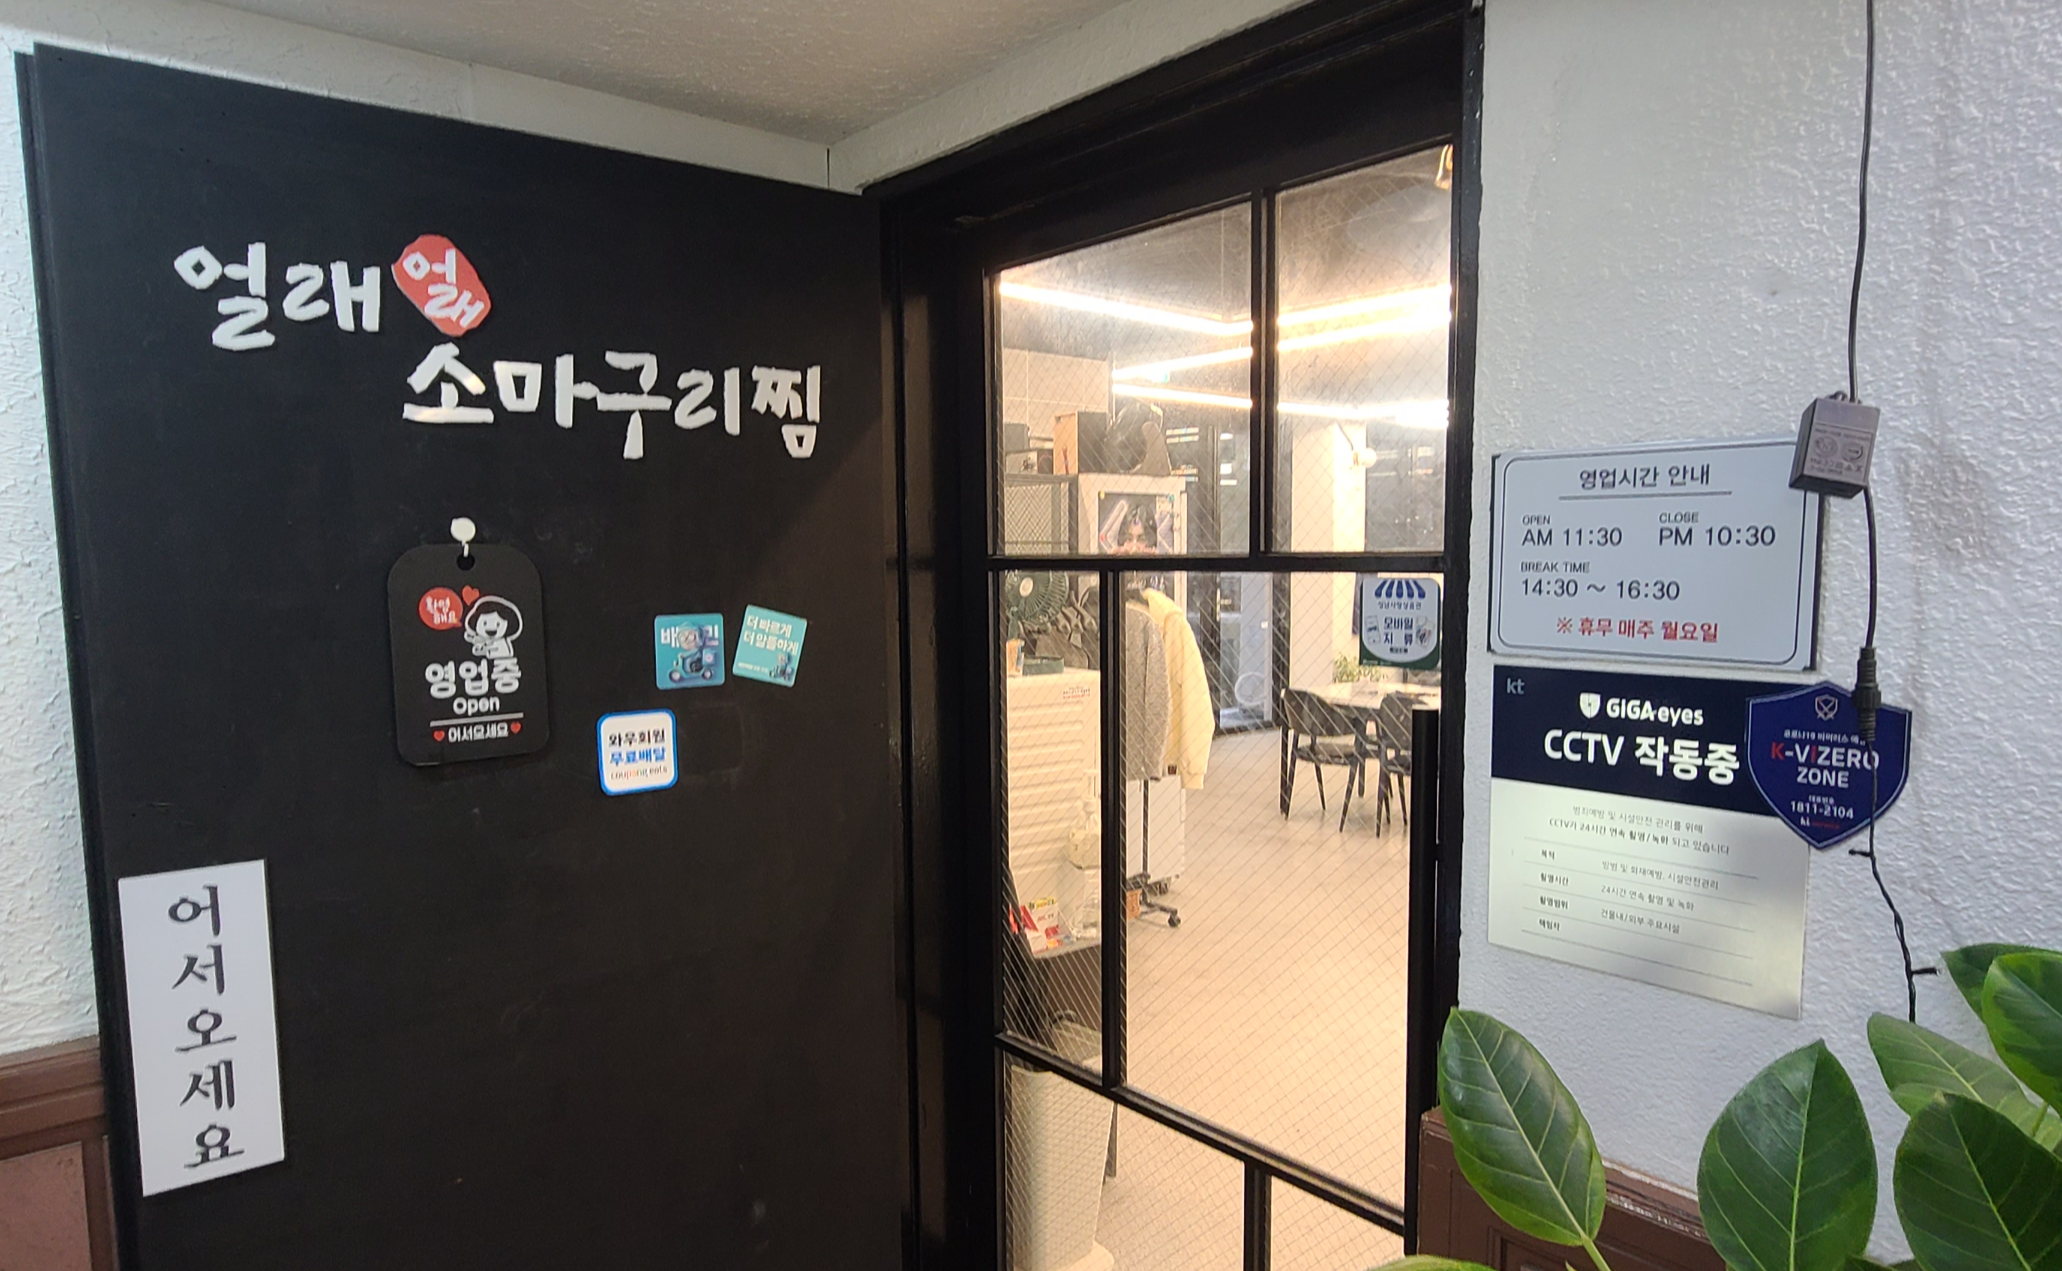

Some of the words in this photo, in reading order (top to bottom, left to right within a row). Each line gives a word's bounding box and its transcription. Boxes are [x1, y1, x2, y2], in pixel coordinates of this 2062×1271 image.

[174, 241, 381, 351] 얼래
[402, 341, 821, 460] 소마구리찜
[1579, 466, 1660, 490] 영업시간
[1668, 463, 1711, 488] 안내
[1522, 514, 1551, 527] OPEN
[1659, 511, 1700, 524] CLOSE
[1521, 528, 1553, 547] AM
[1562, 527, 1624, 547] 11:30
[1658, 527, 1693, 547] PM
[1705, 525, 1777, 547] 10:30
[1520, 562, 1558, 573] BREAK
[1562, 562, 1591, 573] TIME
[1521, 578, 1579, 598] 14:30
[1615, 580, 1681, 601] 16:30
[746, 615, 757, 630] 더
[759, 618, 793, 639] 빠르게
[1383, 616, 1413, 631] 모바일
[1578, 617, 1614, 638] 휴무
[1618, 619, 1655, 640] 매주
[1661, 621, 1720, 643] 월요일
[743, 630, 754, 645] 더
[756, 633, 799, 657] 알뜰하게
[425, 657, 522, 699] 영업중
[1506, 678, 1525, 695] kt
[453, 696, 501, 717] Open
[448, 722, 509, 743] 어서오세요
[609, 728, 666, 747] 와우회원
[610, 747, 666, 767] 무료배달
[1544, 729, 1625, 766] CCTV
[1634, 736, 1740, 786] 작동중
[1770, 742, 1880, 770] K-VIZERO
[1796, 766, 1849, 788] ZONE
[1572, 805, 1605, 820] 범죄예방
[1607, 810, 1616, 821] 및
[1618, 811, 1653, 827] 시설안전
[1655, 815, 1682, 832] 관리를
[1685, 821, 1704, 834] 위해
[1790, 801, 1854, 819] 1811-2104
[1549, 818, 1577, 831] CCTV가
[1579, 822, 1607, 836] 24시간
[1609, 826, 1626, 839] 연속
[1672, 837, 1690, 849] 되고
[1692, 840, 1730, 856] 있습니다
[1602, 860, 1618, 872] 방범
[1620, 863, 1628, 874] 및
[1668, 872, 1719, 891] 시설안전관리
[1601, 885, 1627, 898] 24시간
[1629, 889, 1645, 902] 연속
[1648, 893, 1664, 906] 촬영
[1666, 897, 1675, 908] 및
[1677, 900, 1695, 912] 녹화
[1647, 918, 1681, 935] 주요시설
[168, 885, 245, 1169] 어서오세요
